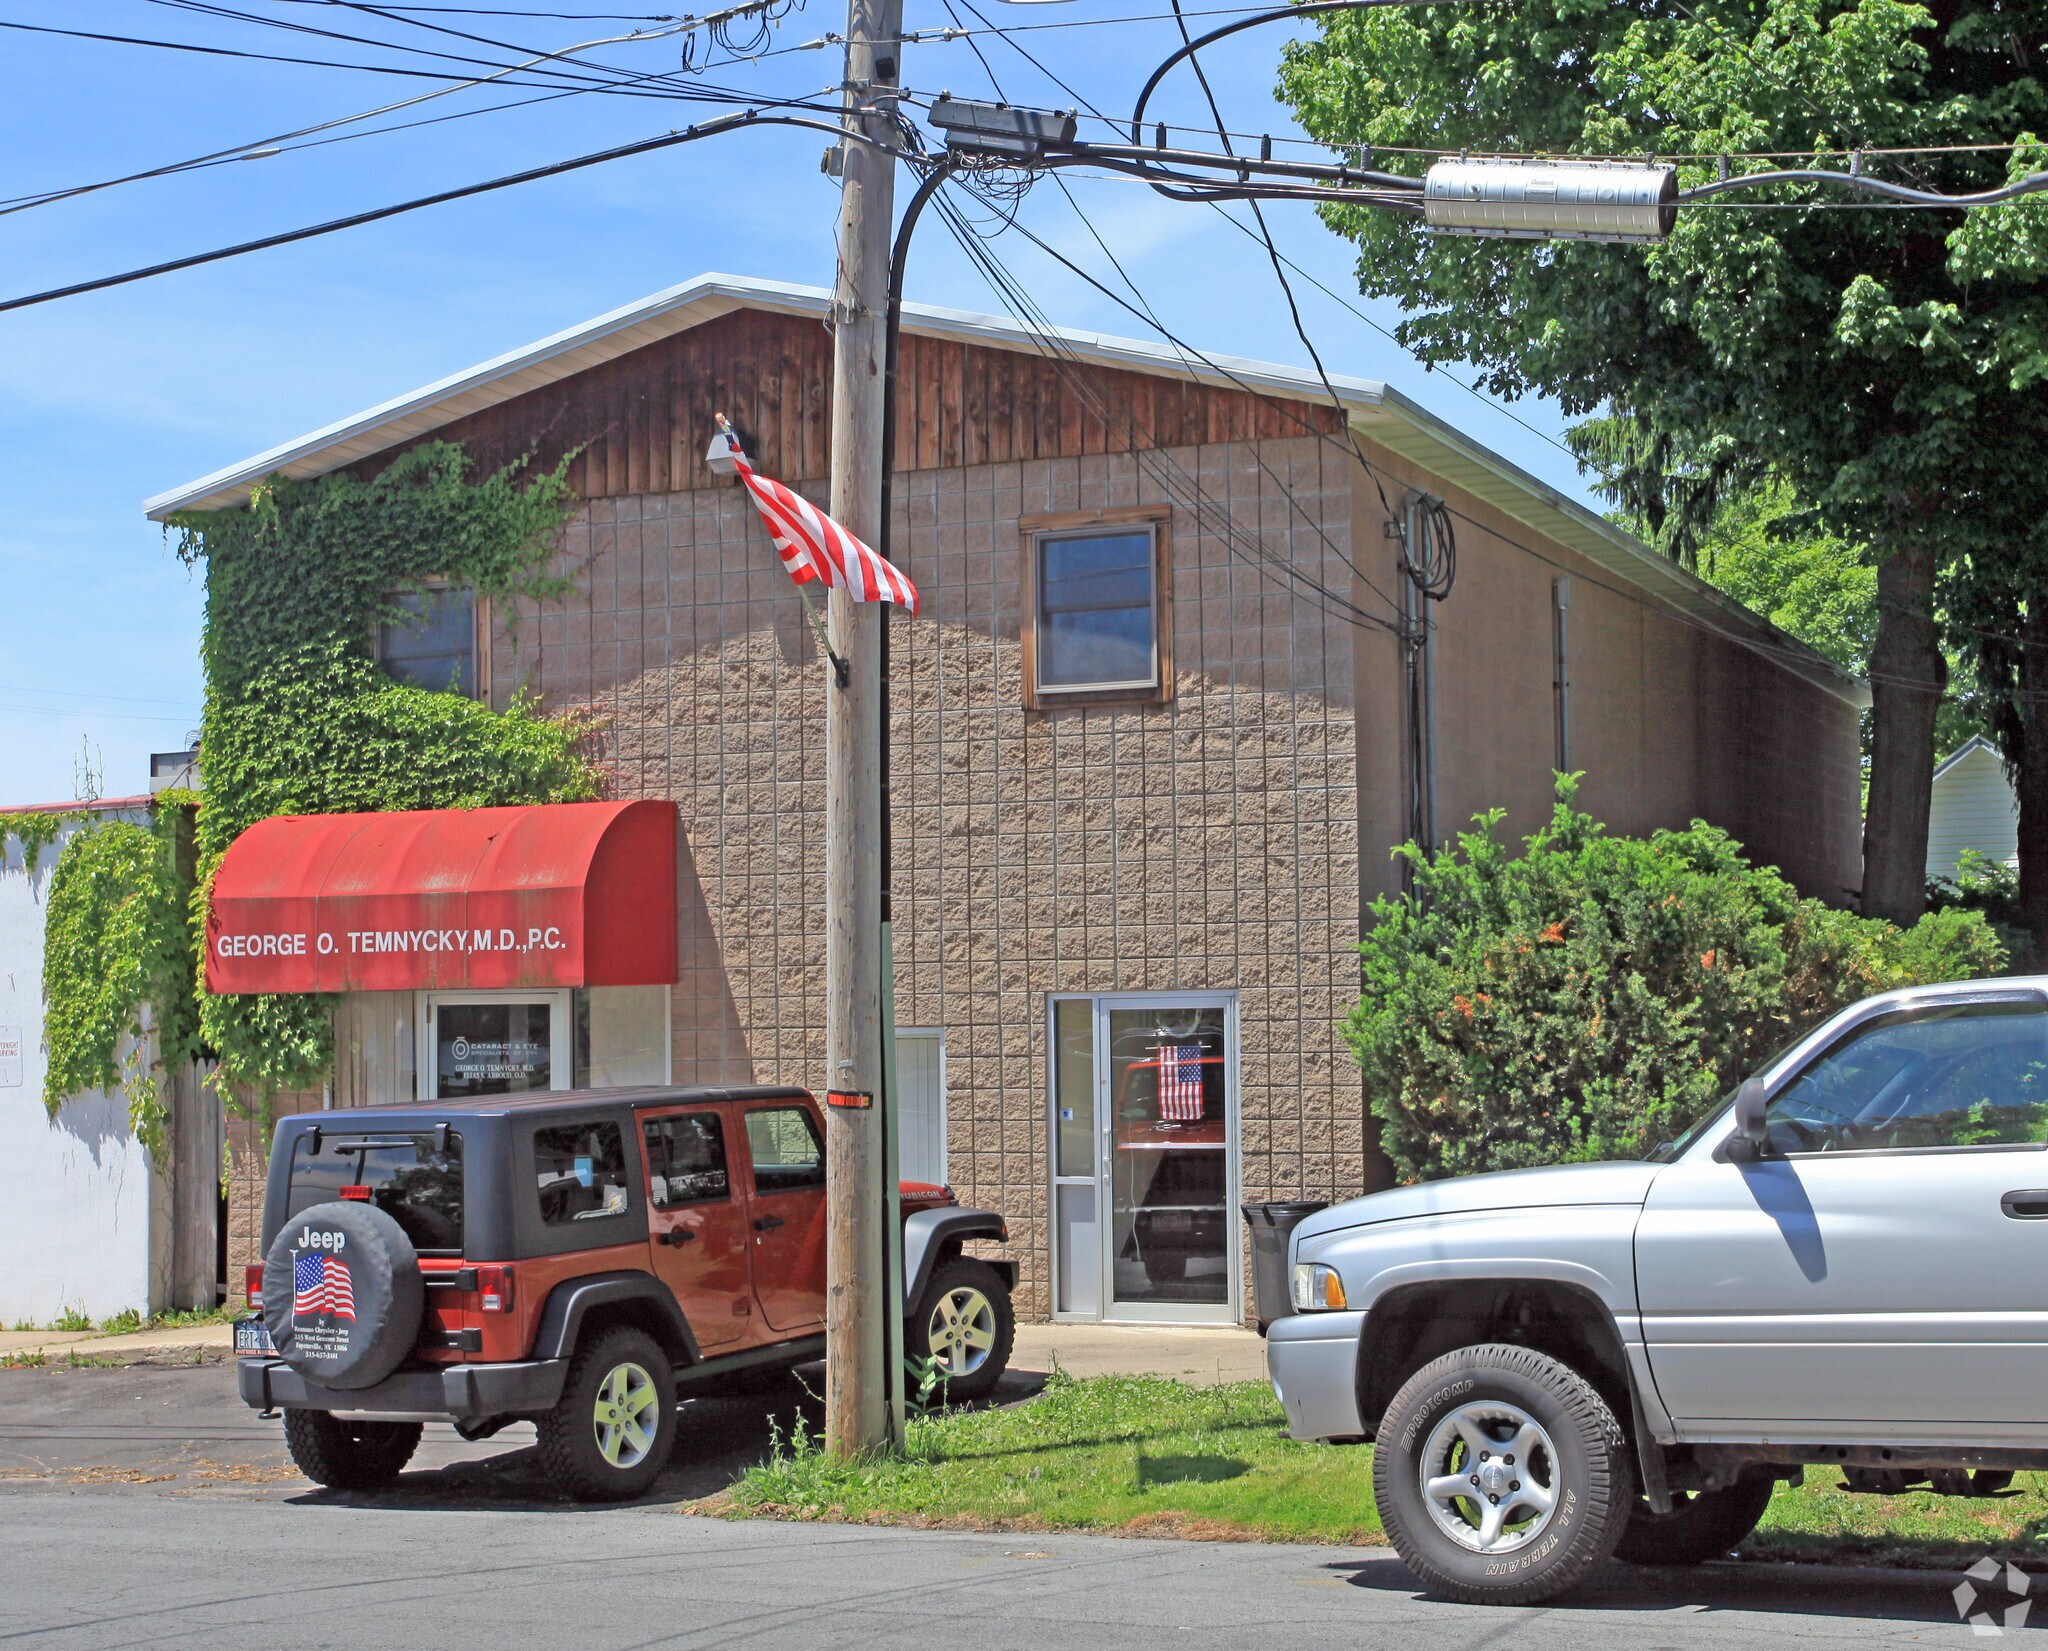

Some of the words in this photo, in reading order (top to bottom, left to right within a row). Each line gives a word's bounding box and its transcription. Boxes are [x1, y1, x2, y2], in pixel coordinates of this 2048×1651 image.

[217, 934, 307, 957] GEORGE
[317, 932, 339, 955] O.
[0, 1041, 18, 1050] ERNIGHT
[455, 1064, 479, 1072] GEORGE
[298, 1226, 346, 1254] Jeep
[318, 1318, 325, 1326] by
[315, 1327, 335, 1335] Chrysler
[338, 1328, 349, 1336] Jeep
[1558, 1488, 1577, 1527] ALL
[1485, 1533, 1559, 1576] TERRAIN
